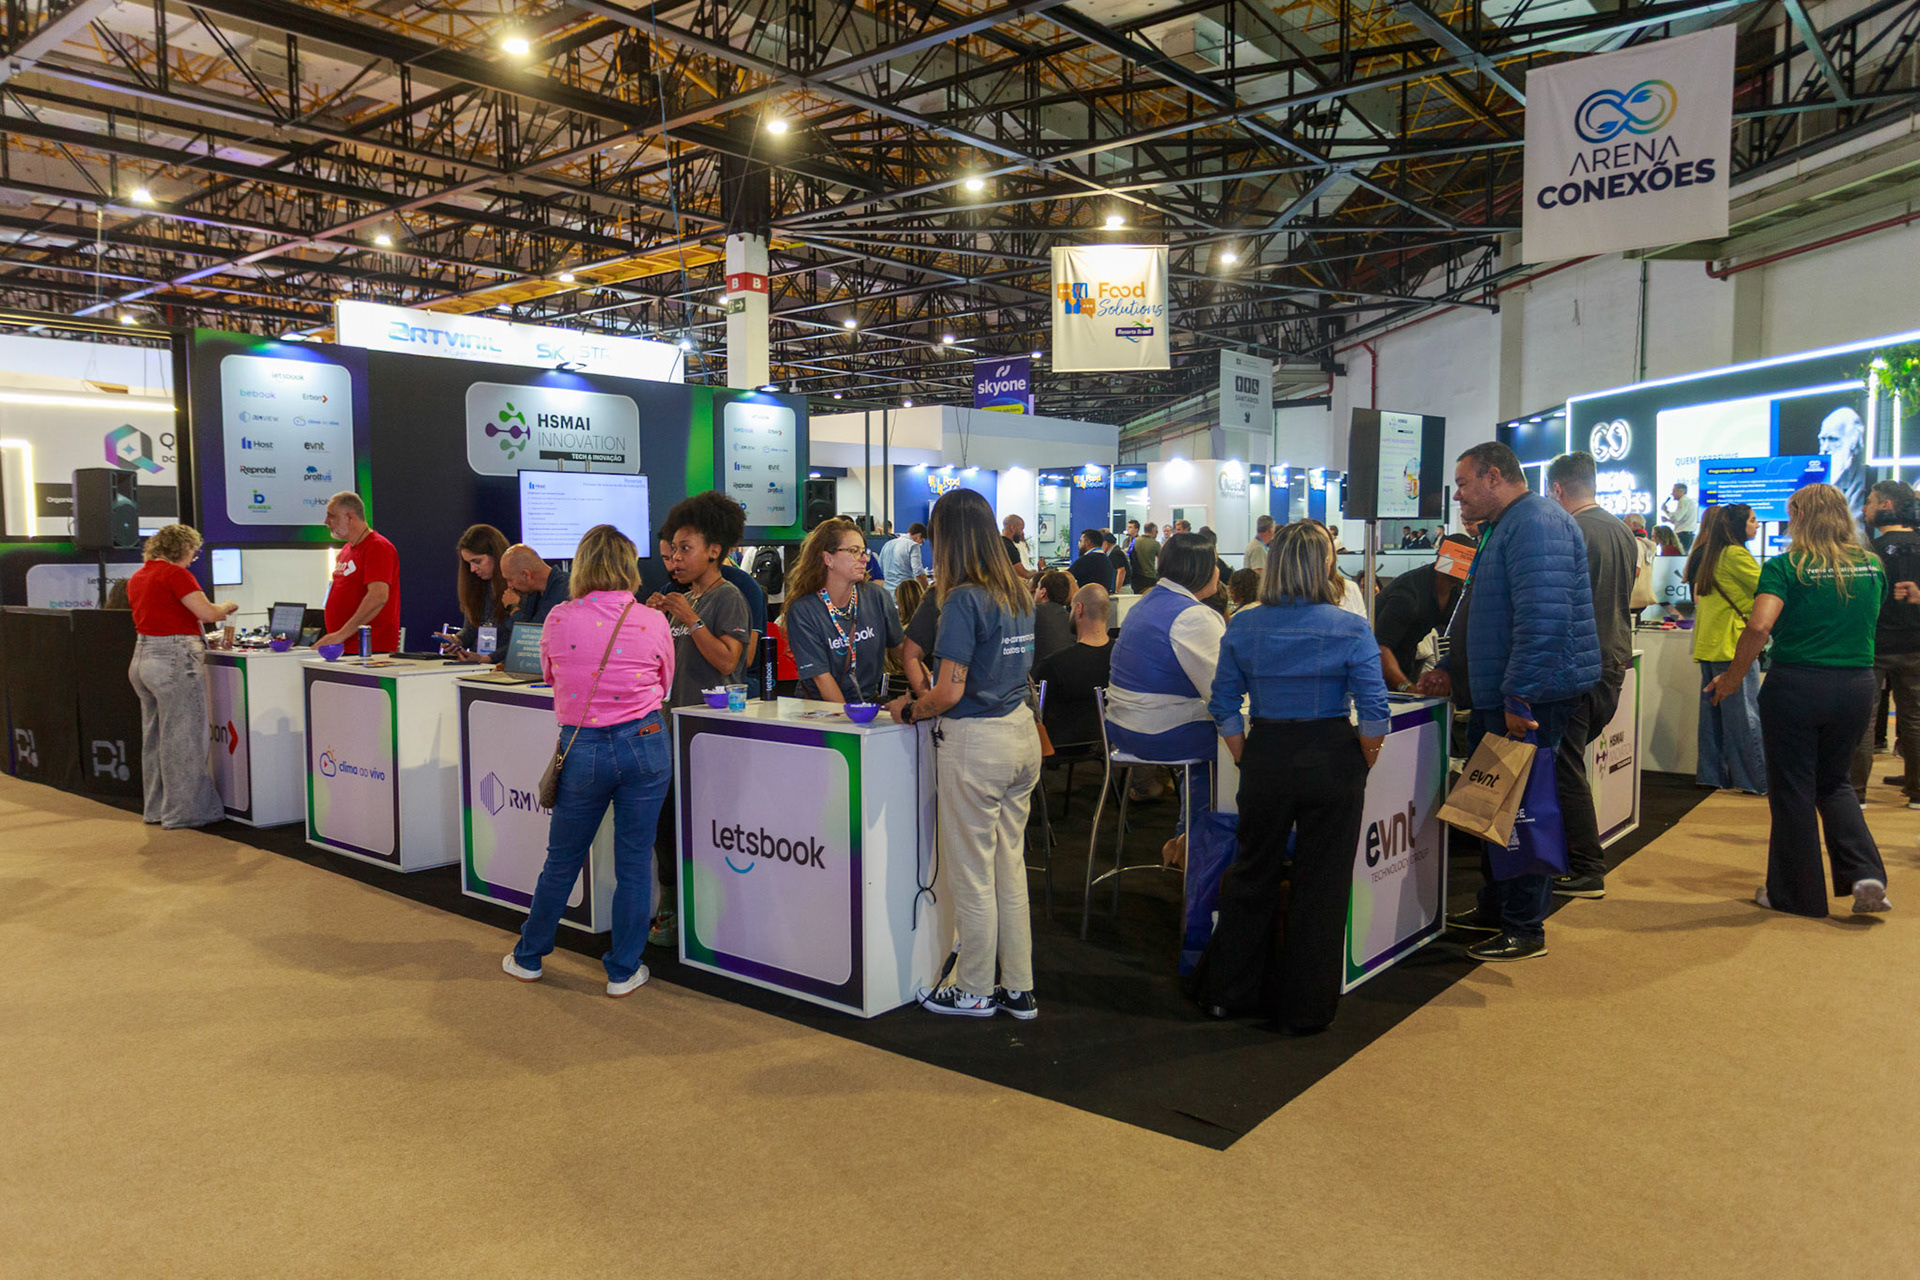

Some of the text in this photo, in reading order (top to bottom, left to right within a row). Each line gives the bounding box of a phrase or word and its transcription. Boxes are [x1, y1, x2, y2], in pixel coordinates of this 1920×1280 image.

[1569, 135, 1680, 177] ARENA
[1537, 158, 1716, 210] CONEXÕES
[731, 277, 739, 289] B
[752, 277, 761, 289] B
[1098, 281, 1146, 298] Food
[1097, 298, 1163, 317] Solutions
[240, 389, 276, 399] bebook
[977, 378, 1026, 396] skyone
[537, 413, 590, 431] HSMAI
[253, 440, 274, 449] Host
[304, 442, 324, 451] evnt
[537, 432, 626, 451] INNOVATION
[240, 465, 276, 475] Reprotel
[339, 761, 385, 781] clima ao vivo
[1469, 769, 1500, 788] evnt
[1366, 800, 1416, 868] evnt
[711, 819, 826, 870] letsbook
[1371, 857, 1409, 884] TECHNOLOGY
